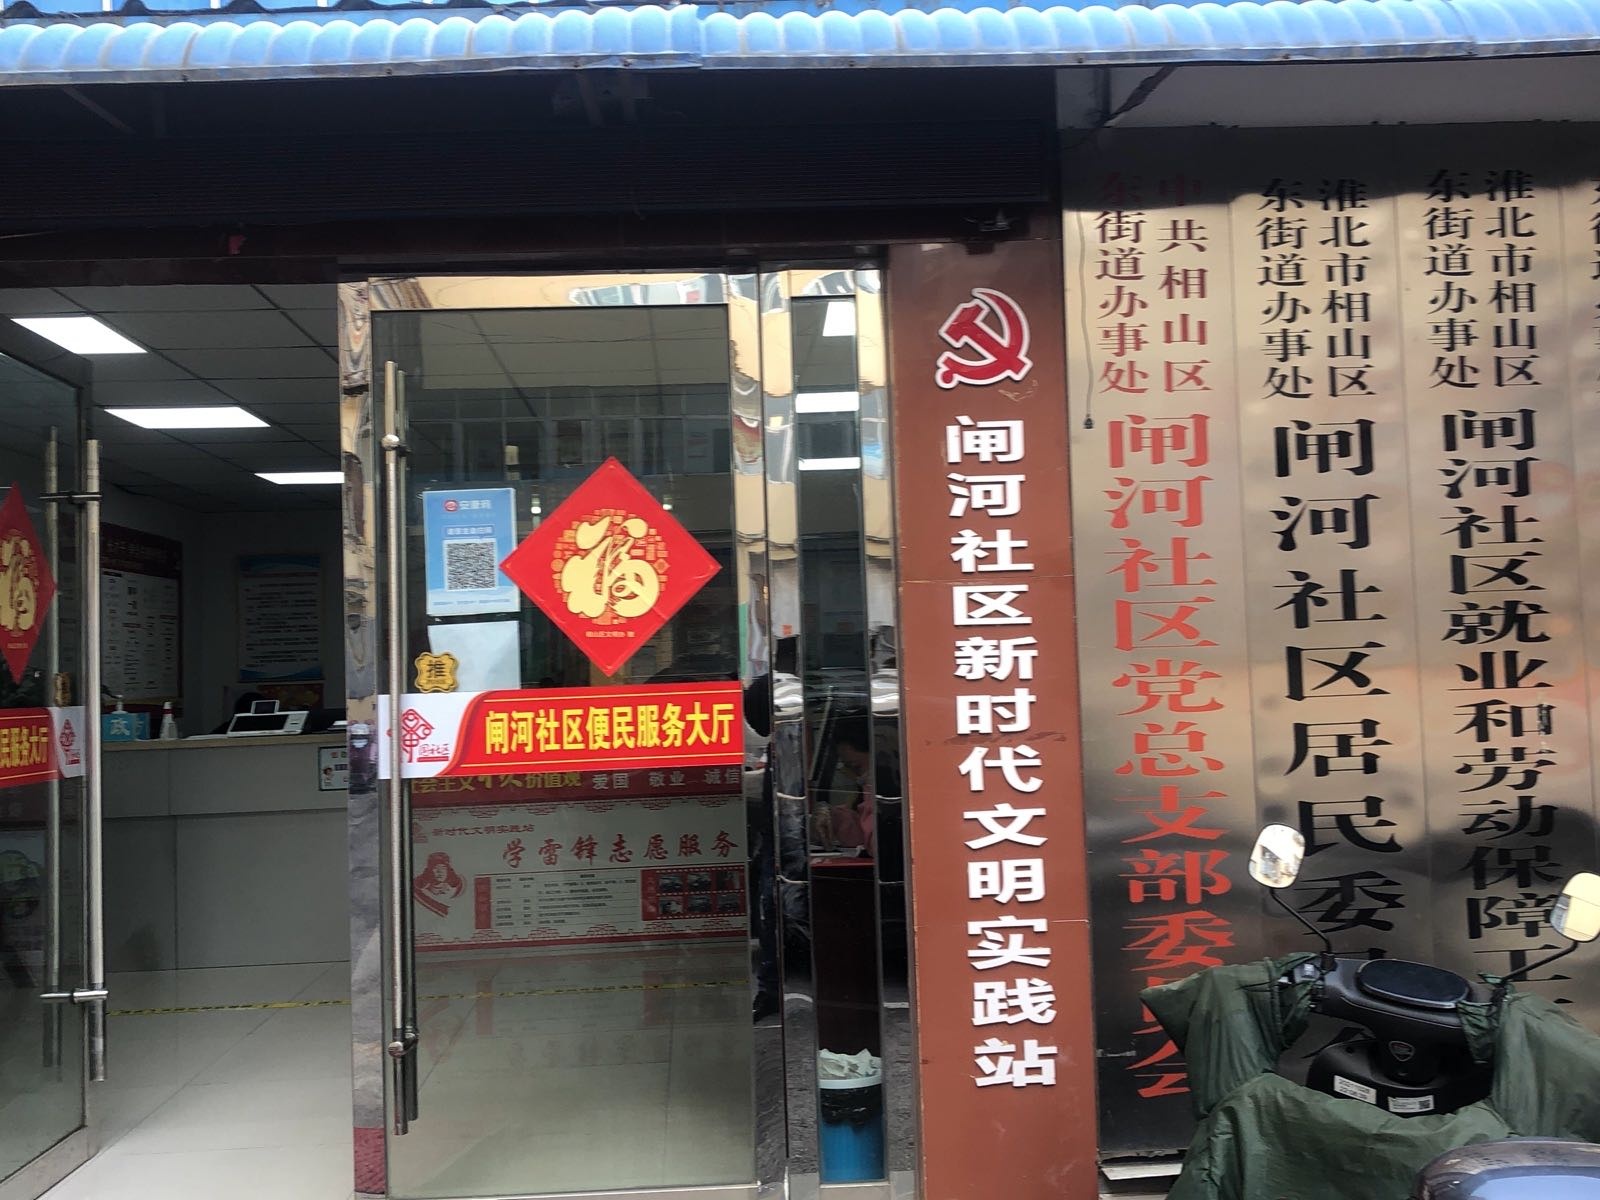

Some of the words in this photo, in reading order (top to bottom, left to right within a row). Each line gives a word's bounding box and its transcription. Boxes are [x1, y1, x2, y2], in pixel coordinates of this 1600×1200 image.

[1094, 172, 1149, 394] 东街道办事处
[1158, 173, 1213, 393] 中共相山区
[1257, 178, 1312, 399] 东街道办事处
[1316, 178, 1377, 398] 淮北市相山区
[1424, 168, 1480, 389] 东街道办事处
[1484, 168, 1543, 388] 淮北市相山区
[561, 516, 660, 618] 福
[485, 702, 735, 755] 闸河社区便民服务大厅
[592, 772, 630, 790] 爱国
[649, 771, 686, 788] 敬业
[704, 768, 740, 785] 诚信
[945, 415, 1058, 1088] 闸河社区新时代文明实践站
[1269, 418, 1405, 1058] 闸河社区居民委
[1437, 408, 1573, 1004] 闸河社区就业和劳动保障工
[502, 830, 739, 869] 学雷锋志愿服务
